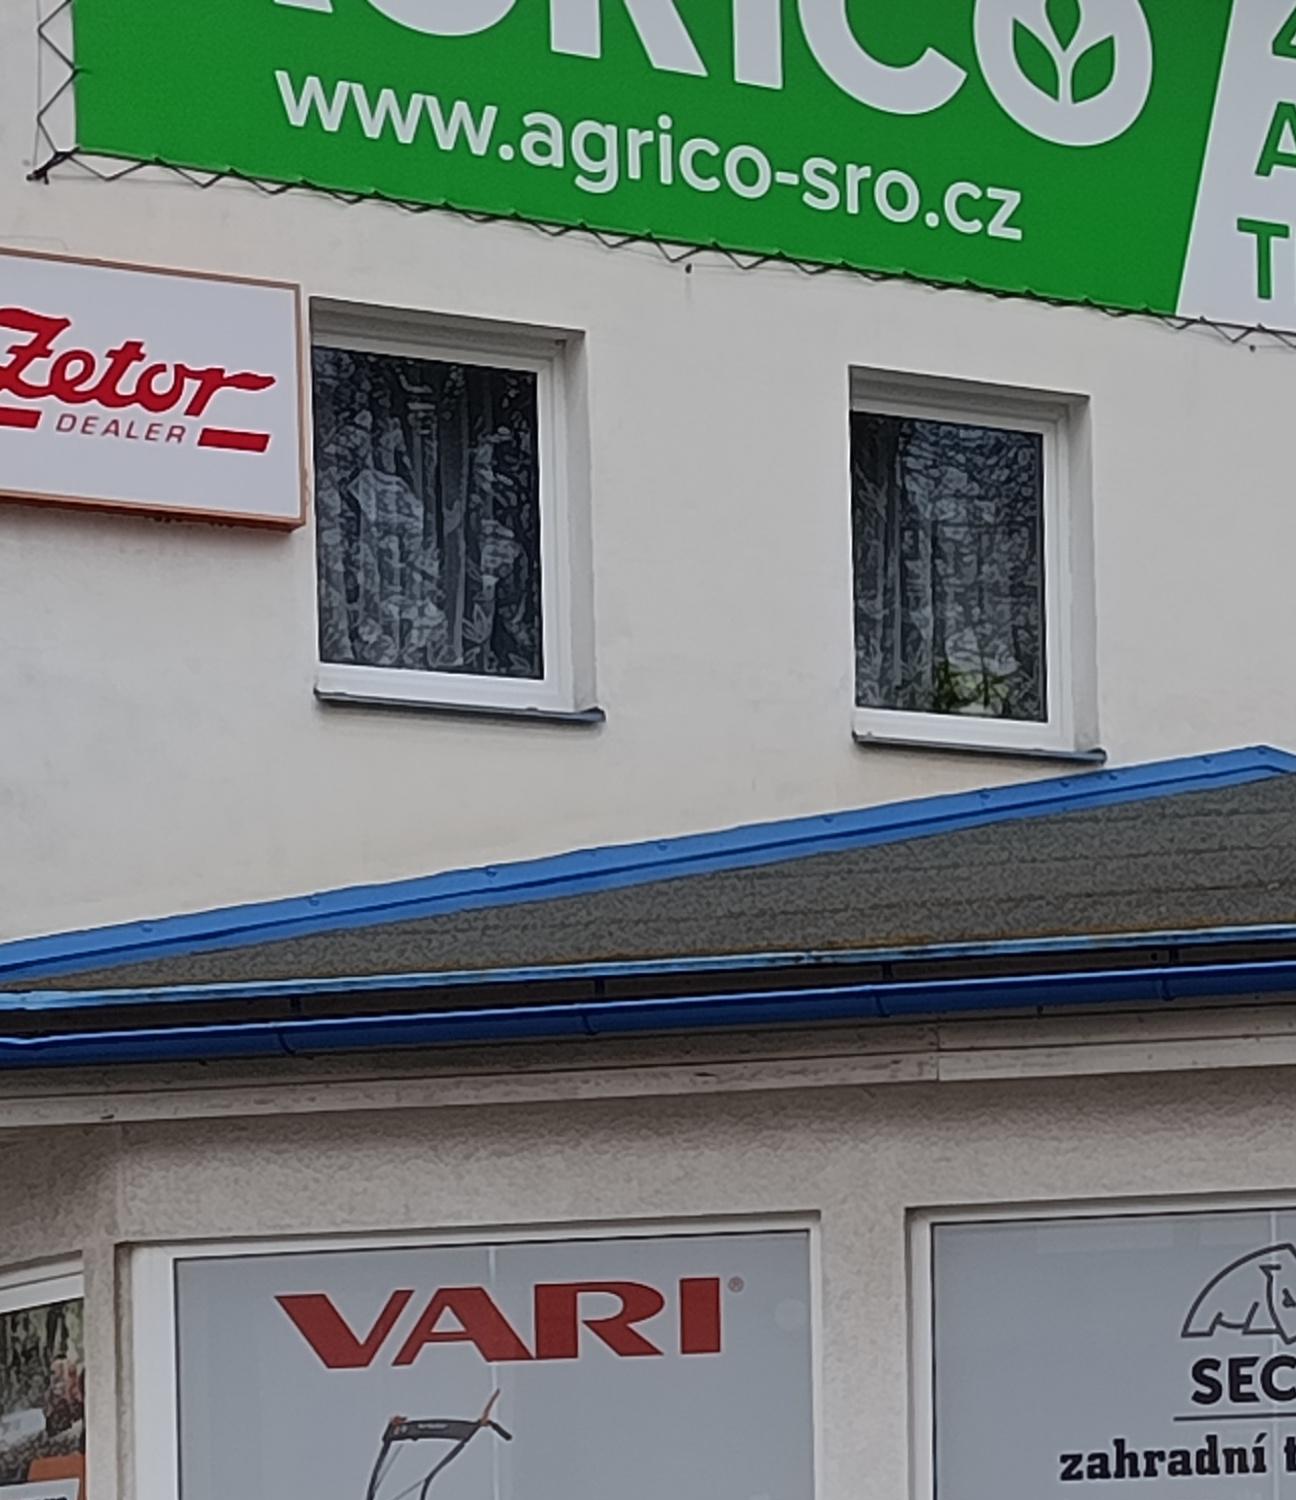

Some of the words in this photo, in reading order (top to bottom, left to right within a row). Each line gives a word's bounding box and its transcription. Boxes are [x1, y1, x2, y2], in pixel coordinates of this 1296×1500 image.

[275, 70, 1022, 241] www.agrico-sro.cz
[0, 308, 275, 417] Zetor
[55, 413, 186, 444] DEALER
[274, 1276, 721, 1370] VARI
[1059, 1433, 1268, 1481] zahradní
